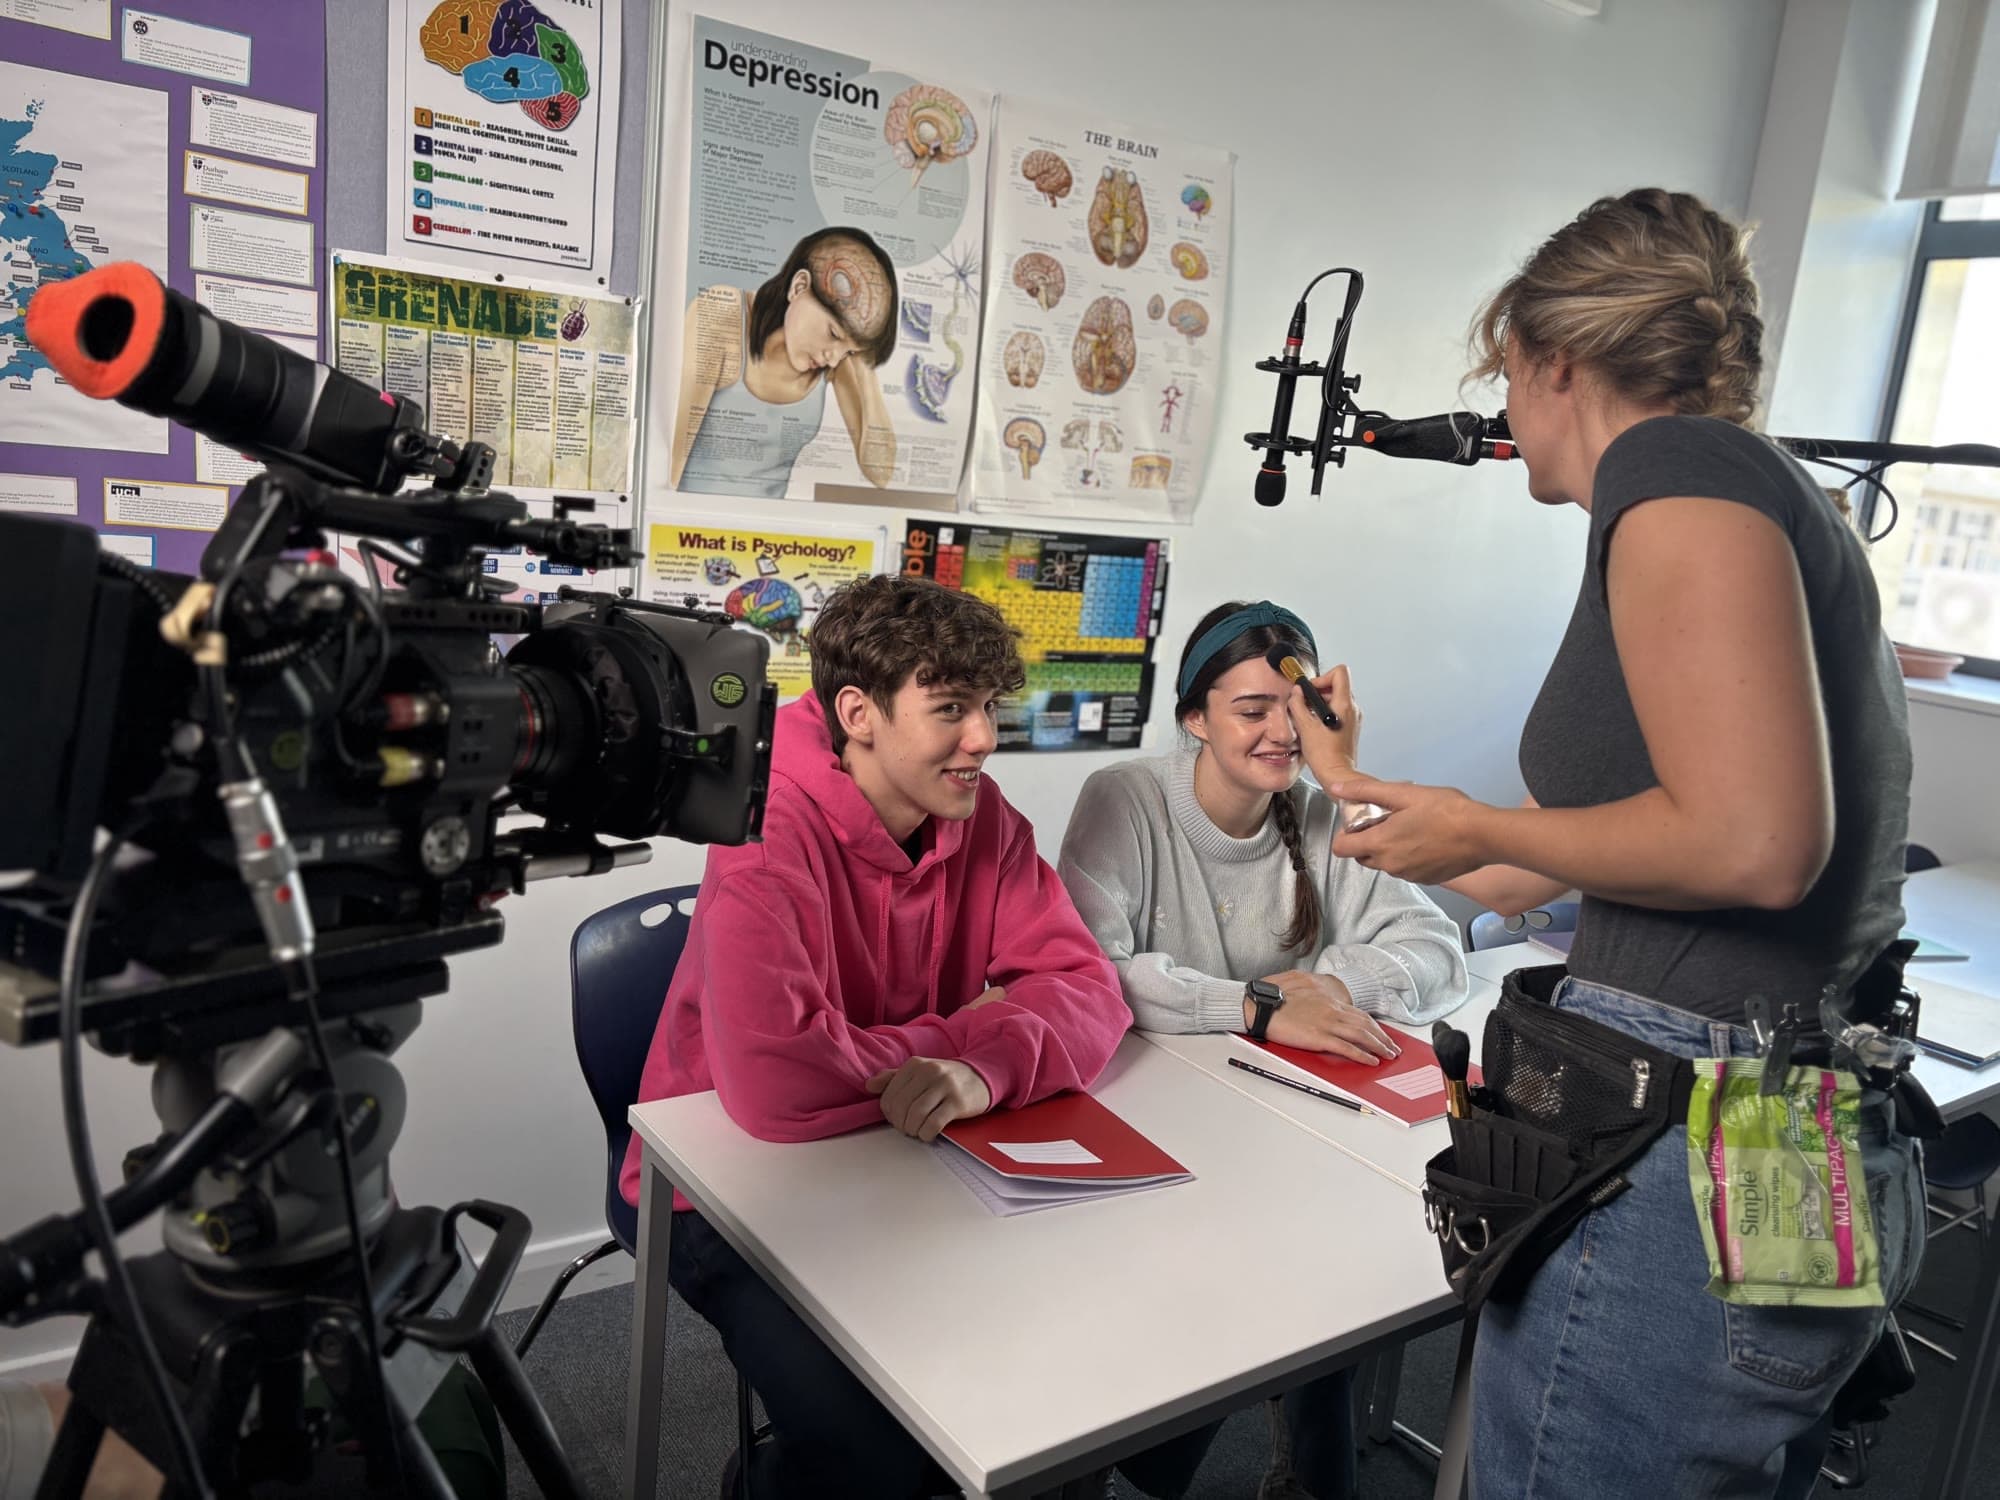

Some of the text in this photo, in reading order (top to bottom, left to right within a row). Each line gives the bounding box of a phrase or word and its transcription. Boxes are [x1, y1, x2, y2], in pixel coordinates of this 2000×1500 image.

[460, 15, 469, 34] 1
[551, 43, 566, 63] 3
[731, 40, 808, 72] understanding
[503, 67, 520, 88] 4
[704, 39, 880, 110] Depression
[1085, 130, 1159, 159] THE BRAIN
[2, 165, 39, 176] SCOTLAND
[345, 269, 559, 340] GRENADE
[115, 487, 138, 497] UCL
[679, 531, 856, 562] What is Psychology?
[1771, 1167, 1781, 1192] wipes
[1739, 1170, 1762, 1237] Simple
[1769, 1195, 1781, 1237] cleansing
